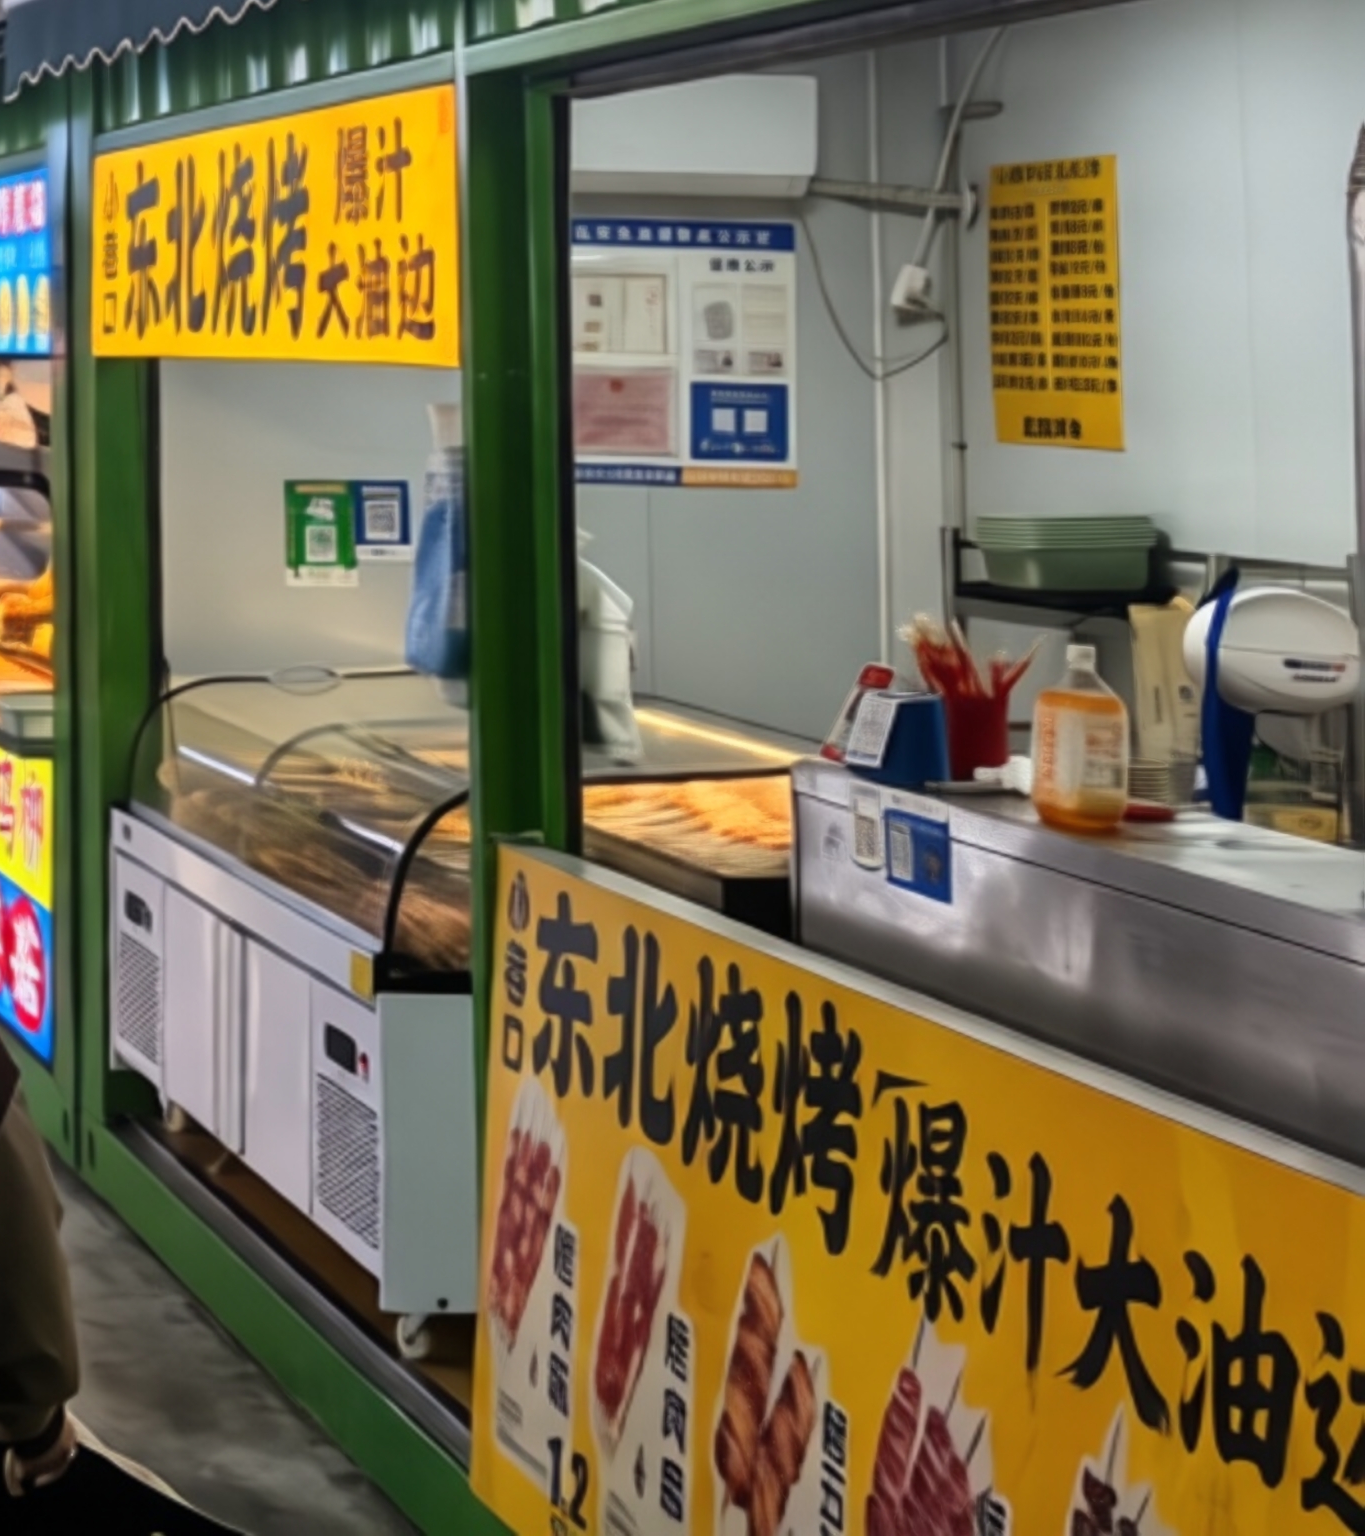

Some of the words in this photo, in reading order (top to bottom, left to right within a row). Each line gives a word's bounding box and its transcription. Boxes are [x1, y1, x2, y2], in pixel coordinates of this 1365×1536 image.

[124, 131, 310, 341] 东北烧烤
[334, 116, 412, 226] 爆汁
[317, 233, 437, 341] 大油边
[533, 892, 863, 1257] 东北烧烤
